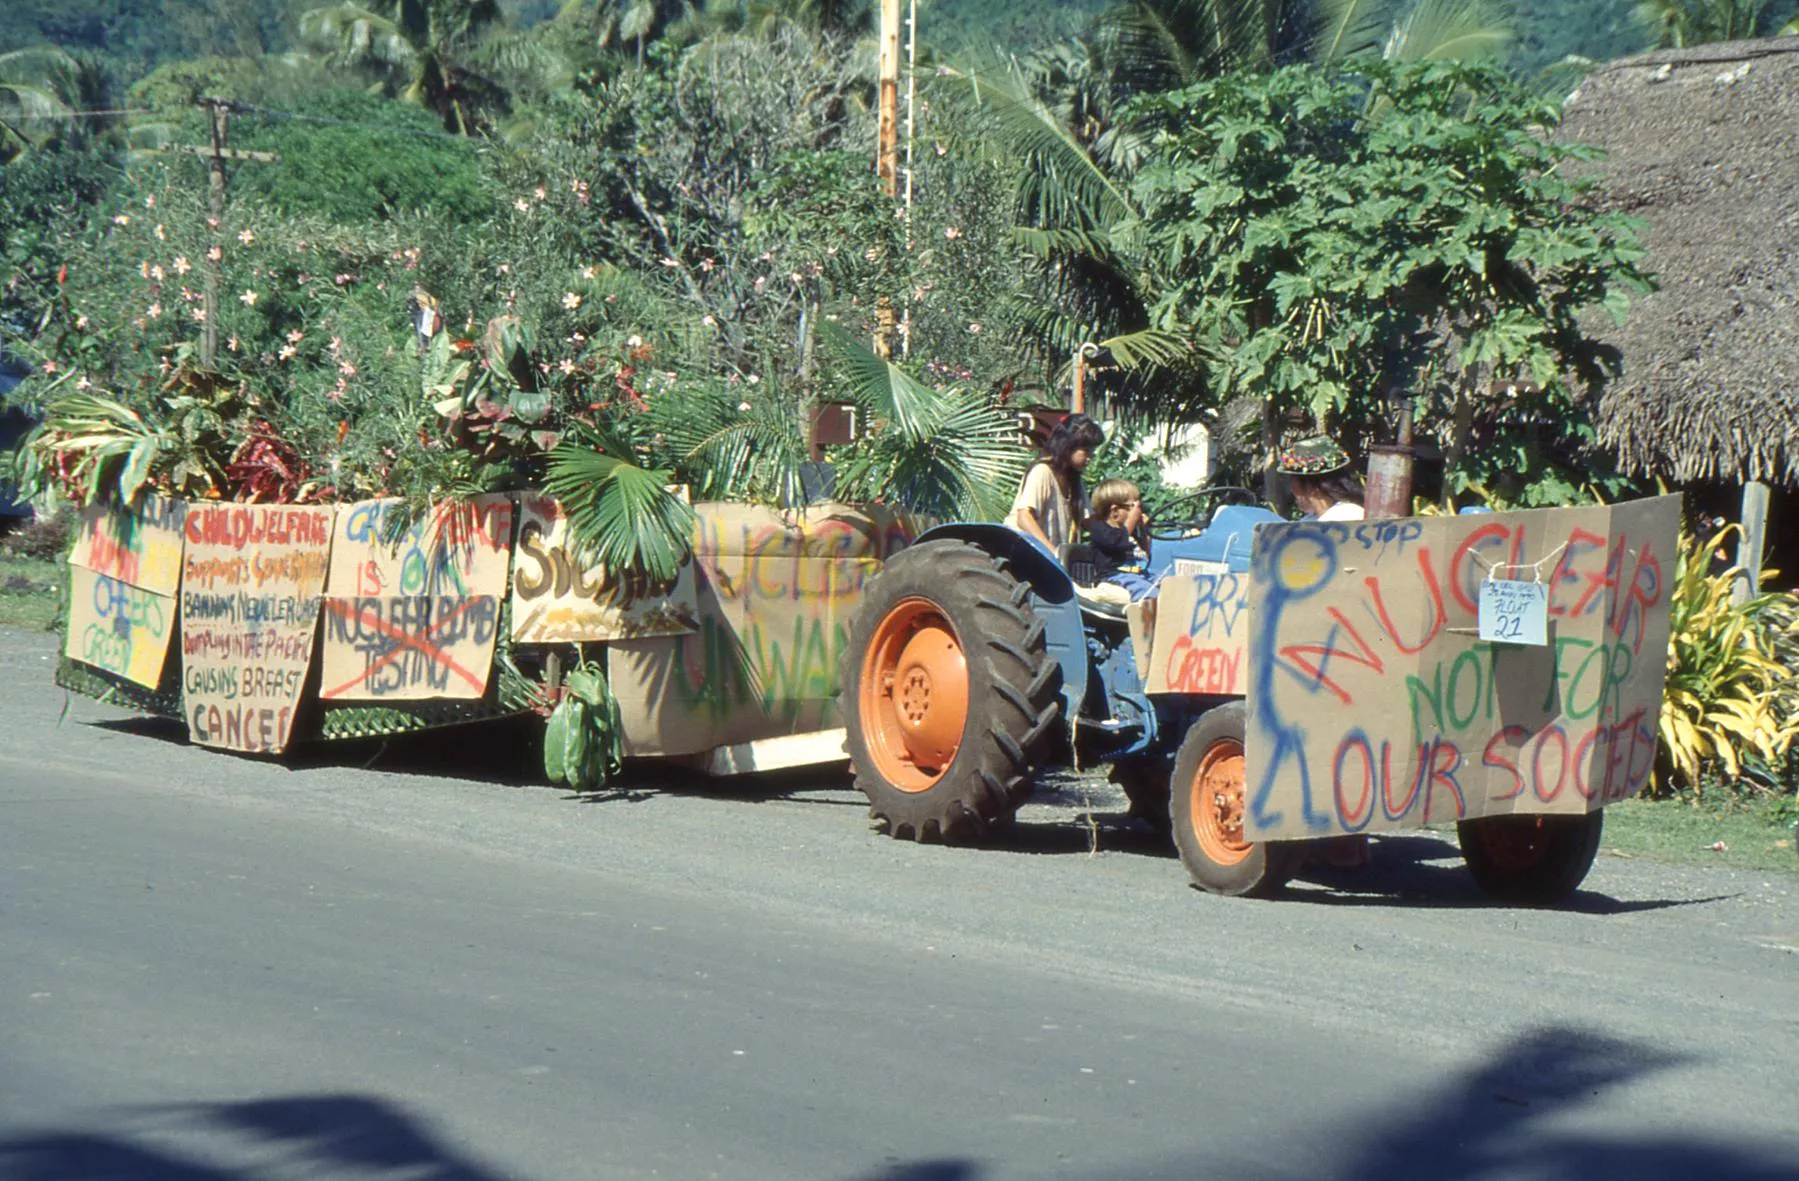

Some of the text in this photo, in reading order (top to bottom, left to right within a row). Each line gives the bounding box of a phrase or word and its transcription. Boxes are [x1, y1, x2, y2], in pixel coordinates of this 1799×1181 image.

[1355, 522, 1423, 557] STOP
[356, 559, 382, 597] IS
[1494, 614, 1523, 639] 21
[1406, 636, 1632, 748] NOT FOR
[1332, 724, 1467, 832] OUR
